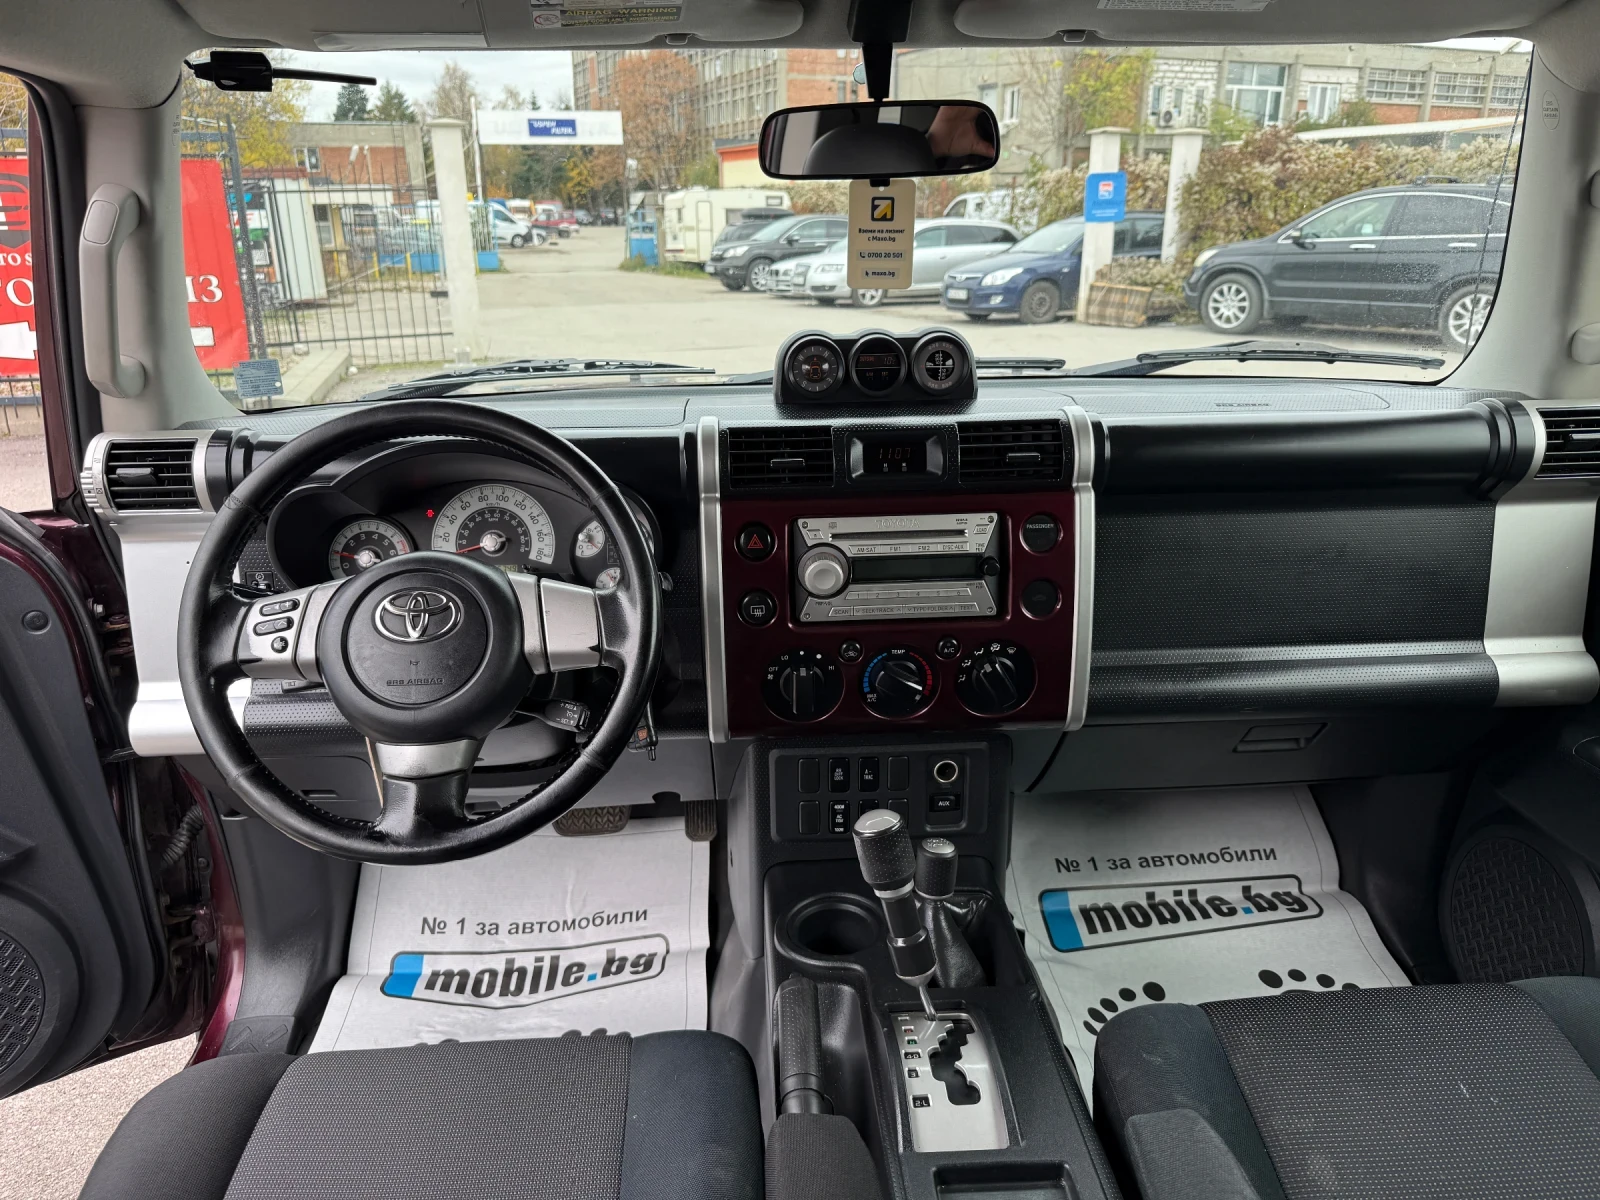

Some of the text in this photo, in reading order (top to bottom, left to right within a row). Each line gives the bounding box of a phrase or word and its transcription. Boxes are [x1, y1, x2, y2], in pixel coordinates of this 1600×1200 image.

[477, 494, 489, 503] 80
[495, 494, 510, 503] 100
[460, 501, 471, 511] 60
[513, 499, 527, 511] 120
[448, 514, 458, 525] 40
[527, 512, 540, 525] 140
[875, 517, 920, 529] TOYOTA
[382, 538, 390, 546] 5
[442, 532, 450, 543] 20
[536, 529, 545, 543] 160
[348, 539, 356, 547] 2
[535, 547, 545, 560] 180
[407, 677, 444, 685] AIRBAG
[1087, 856, 1099, 872] 1
[1106, 858, 1132, 871] за
[1137, 846, 1278, 869] автомобили
[1078, 884, 1309, 935] mobile.bg
[455, 916, 467, 935] 1
[475, 922, 500, 936] за
[507, 908, 649, 936] автомобили
[424, 948, 658, 999] mobile.bg
